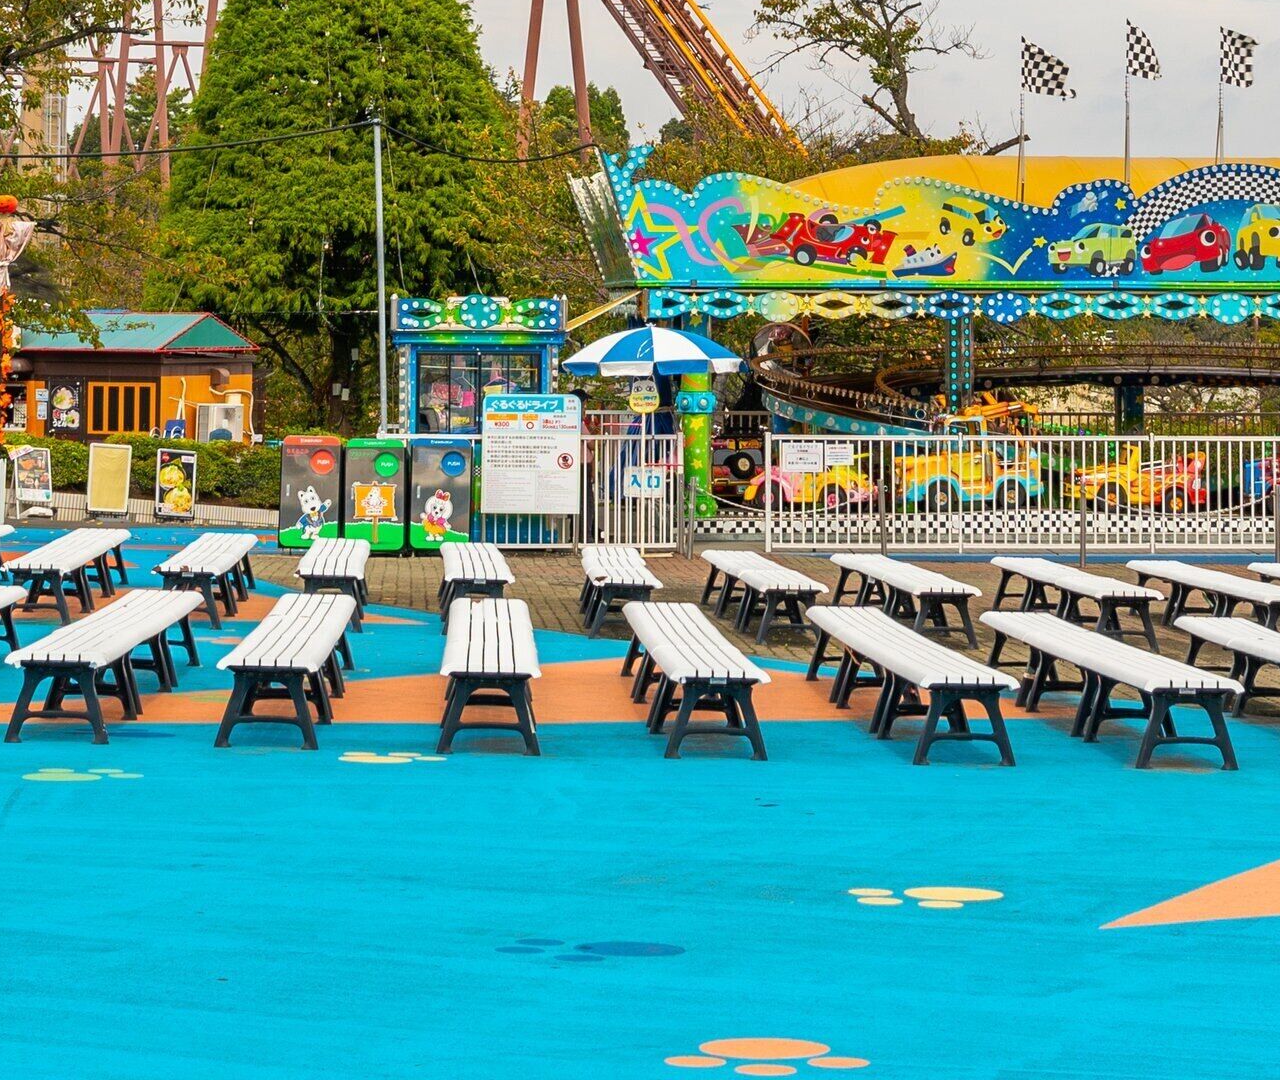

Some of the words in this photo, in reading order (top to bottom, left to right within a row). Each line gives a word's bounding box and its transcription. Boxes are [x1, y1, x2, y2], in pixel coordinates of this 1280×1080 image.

[491, 400, 558, 409] ぐるぐるドライブ
[631, 474, 661, 489] 入口
